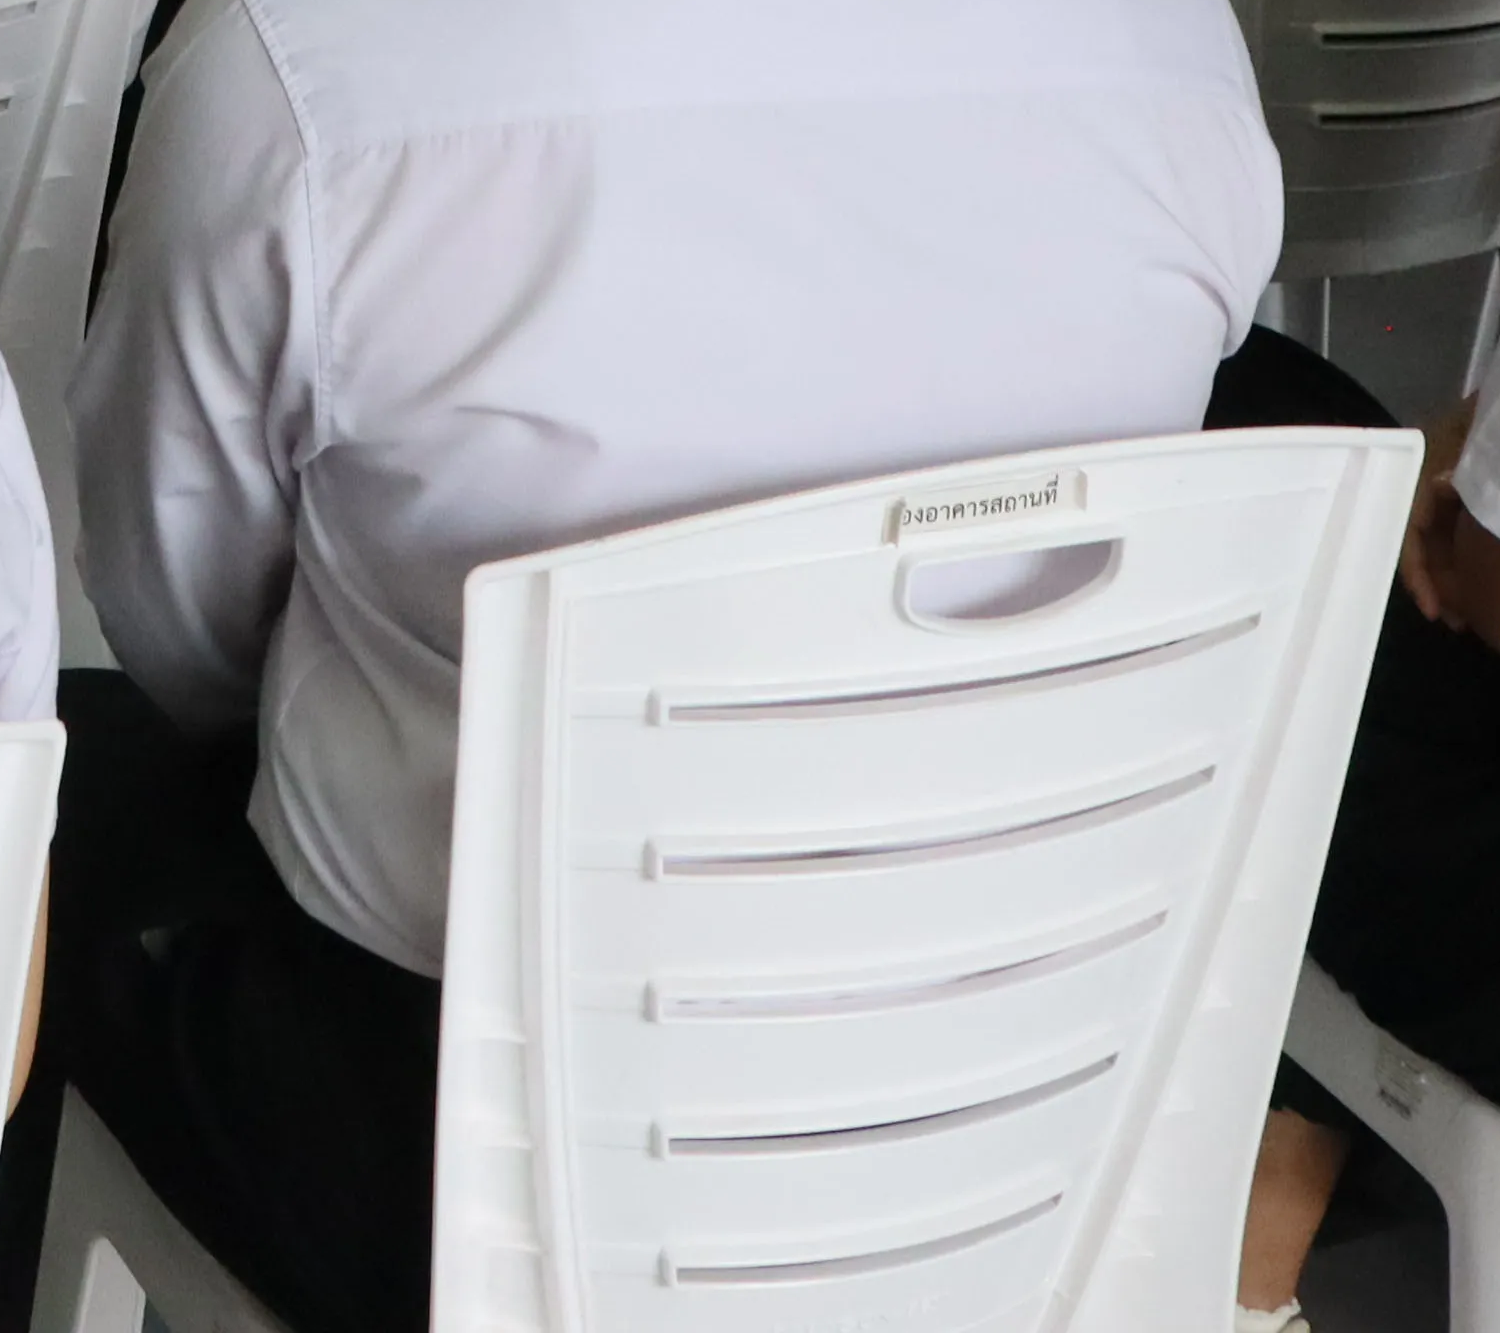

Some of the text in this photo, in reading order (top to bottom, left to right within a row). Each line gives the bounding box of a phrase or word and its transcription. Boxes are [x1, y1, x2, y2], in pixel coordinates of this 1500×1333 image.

[901, 474, 1060, 527] องอาคารสถานที่
